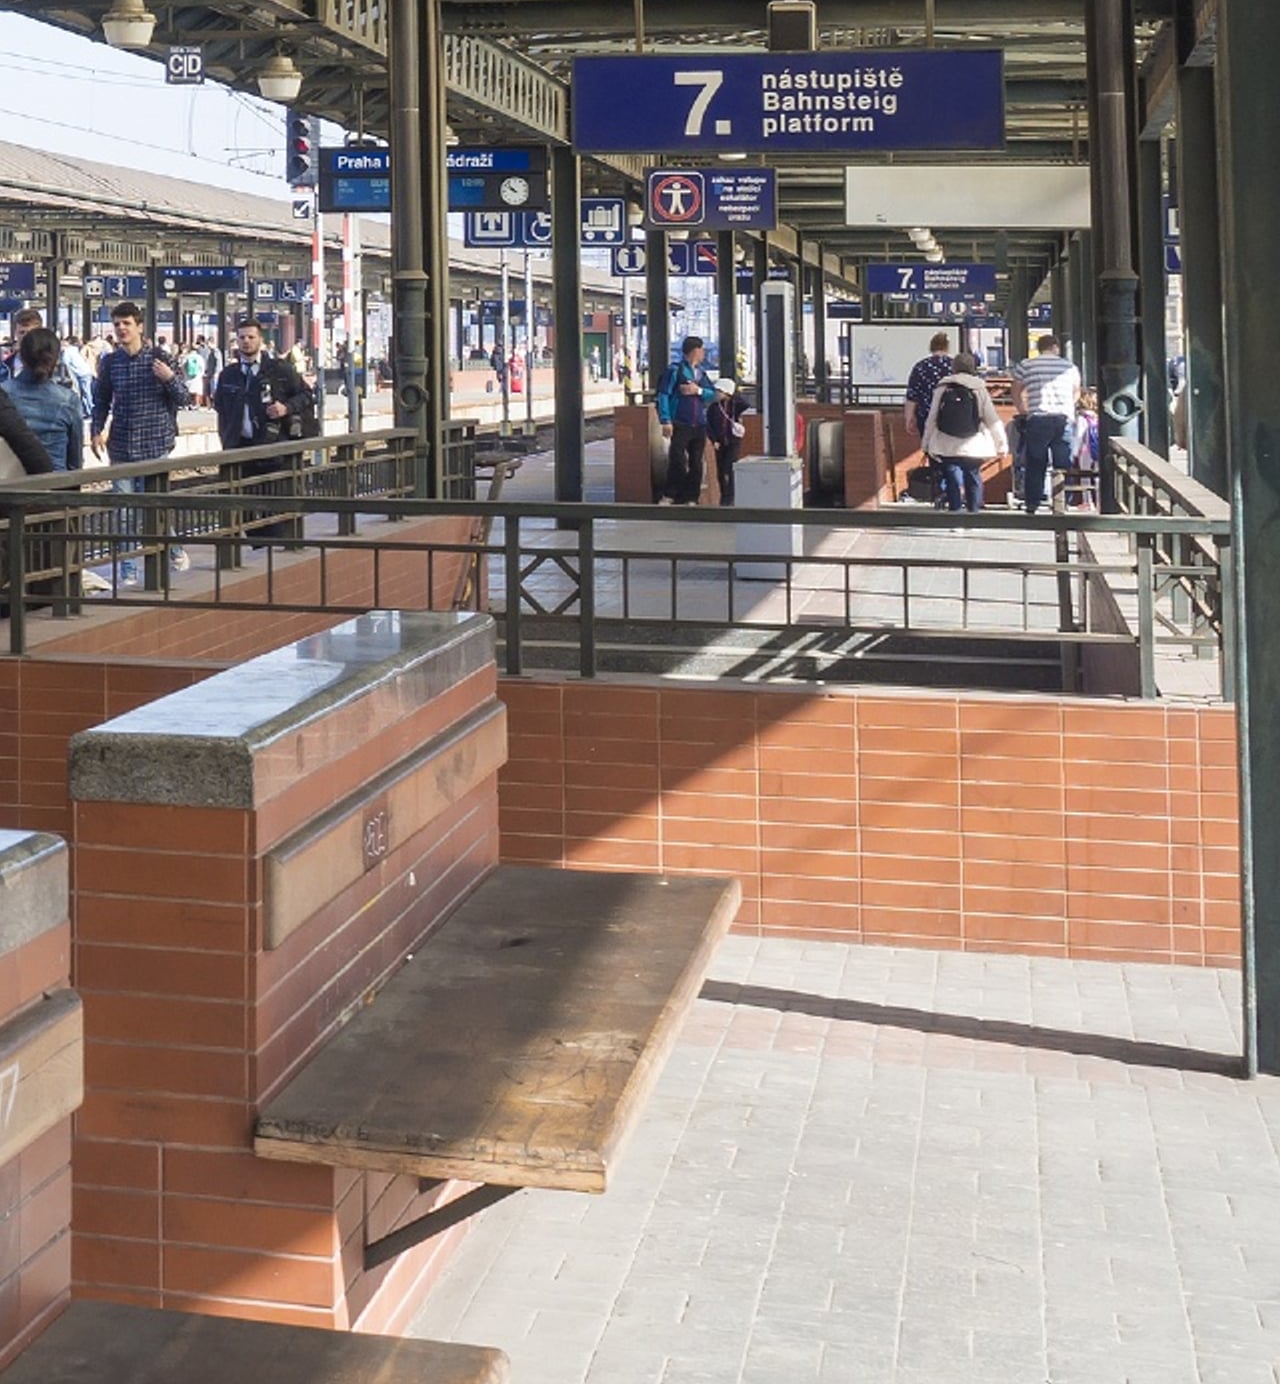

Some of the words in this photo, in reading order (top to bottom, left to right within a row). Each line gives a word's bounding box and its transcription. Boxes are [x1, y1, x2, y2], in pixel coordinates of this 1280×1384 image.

[761, 68, 904, 93] nástupiště
[673, 70, 732, 136] 7.
[762, 91, 898, 115] Bahnsteig
[762, 114, 874, 137] platform
[337, 155, 382, 169] Praha
[445, 153, 494, 168] ádraží
[897, 267, 917, 289] 7.
